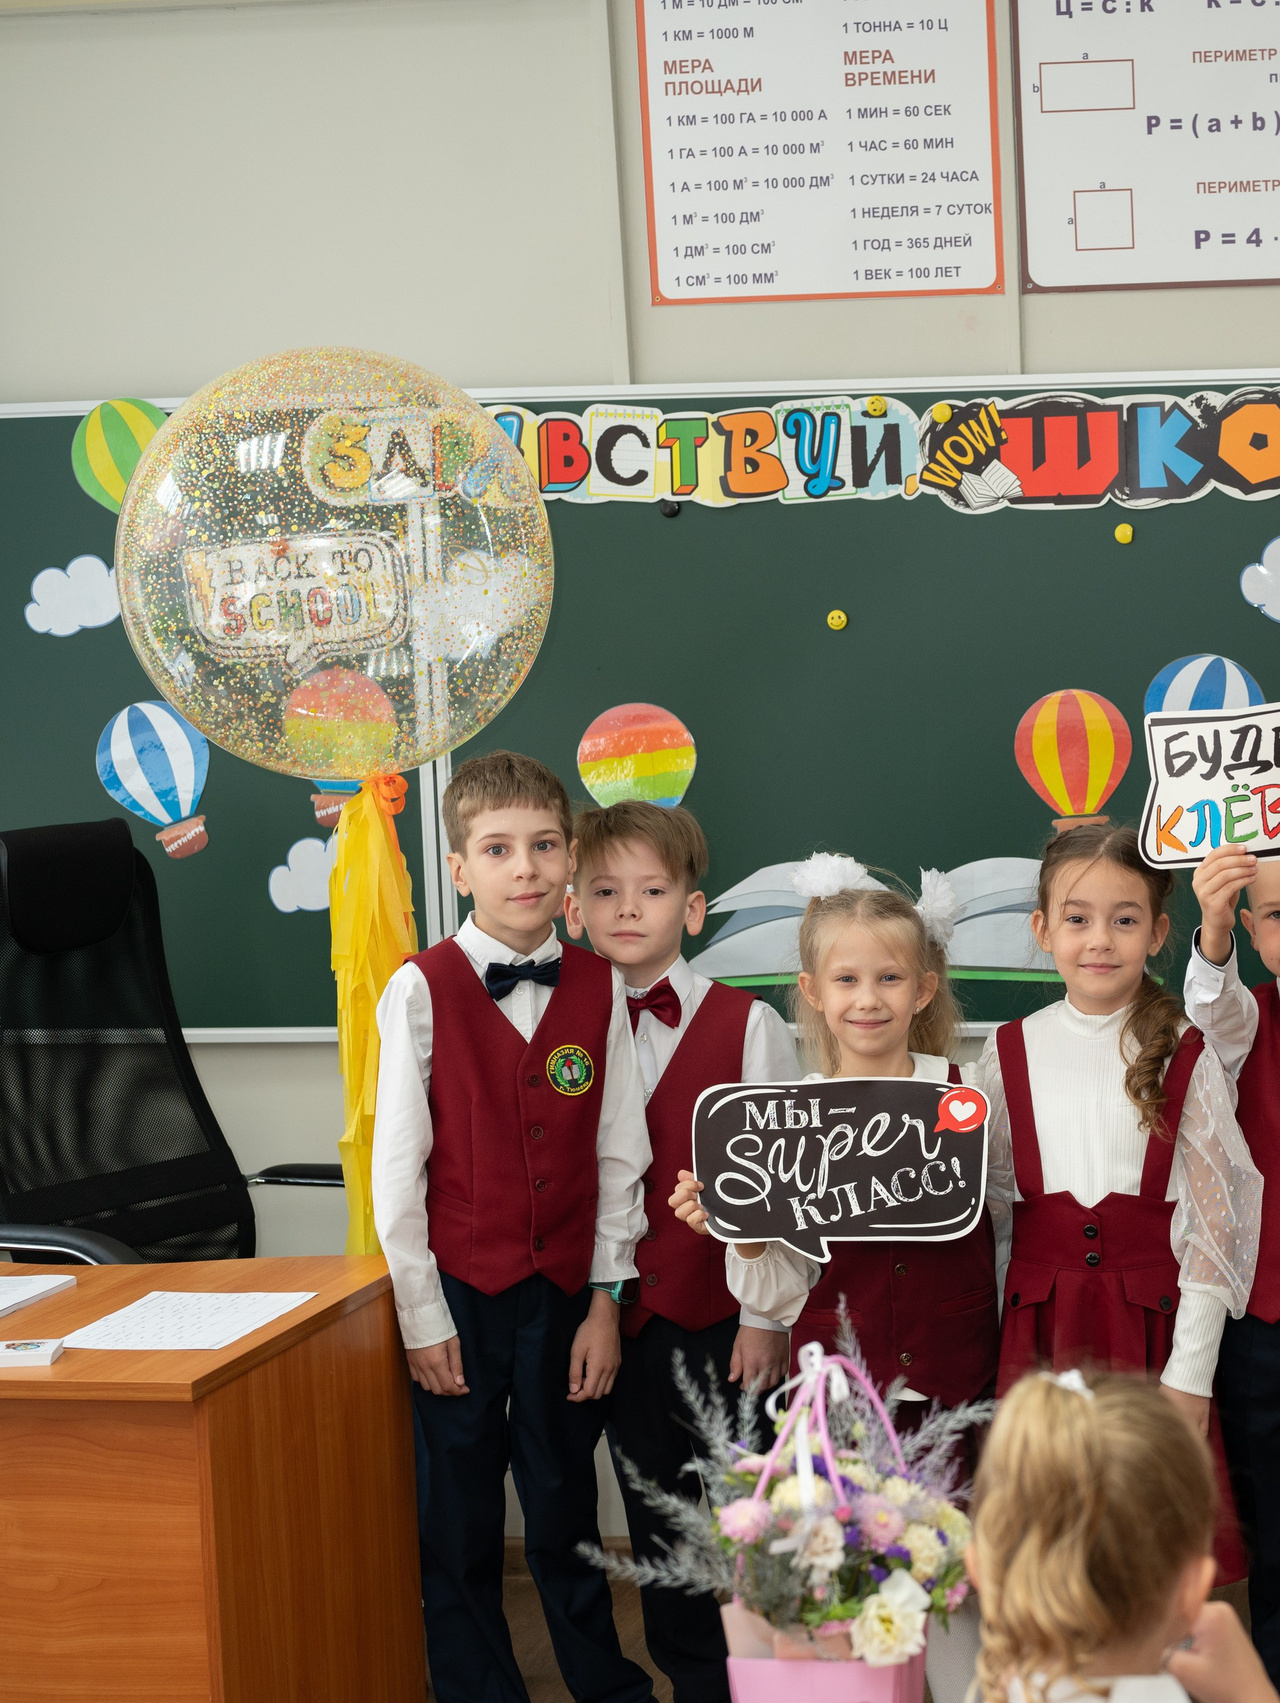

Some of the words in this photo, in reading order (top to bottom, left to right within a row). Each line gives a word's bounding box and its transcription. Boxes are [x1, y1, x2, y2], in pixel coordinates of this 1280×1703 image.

[662, 30, 668, 42] 1
[673, 29, 693, 42] КМ
[708, 27, 739, 40] 1000
[743, 26, 754, 39] М
[842, 22, 848, 34] 1
[853, 20, 903, 34] ТОННА
[918, 18, 934, 31] 10
[938, 18, 949, 32] Ц
[843, 49, 895, 66] МЕРА
[1191, 47, 1278, 64] ПЕРИМЕТР
[663, 58, 715, 75] МЕРА
[844, 68, 936, 87] ВРЕМЕНИ
[664, 77, 762, 97] ПЛОЩАДИ
[666, 115, 672, 127] 1
[677, 114, 697, 127] КМ
[712, 112, 736, 125] 100
[739, 112, 757, 124] ГА
[772, 110, 787, 123] 10
[790, 109, 814, 122] 000
[817, 109, 828, 121] А
[846, 108, 852, 120] 1
[857, 106, 889, 119] МИН
[904, 105, 920, 118] 60
[923, 104, 952, 117] СЕК
[667, 148, 674, 160] 1
[679, 147, 696, 160] ГА
[711, 145, 734, 158] 100
[737, 145, 748, 157] А
[763, 144, 779, 156] 10
[782, 143, 806, 155] 000
[847, 141, 854, 153] 1
[858, 139, 888, 152] ЧАС
[903, 138, 919, 151] 60
[923, 137, 954, 150] МИН
[669, 181, 676, 193] 1
[680, 181, 691, 193] А
[706, 179, 729, 192] 100
[763, 177, 779, 189] 10
[782, 176, 806, 189] 000
[849, 174, 855, 186] 1
[860, 172, 905, 186] СУТКИ
[921, 171, 937, 184] 24
[940, 170, 980, 183] ЧАСА
[671, 214, 677, 226] 1
[713, 212, 736, 224] 100
[850, 207, 857, 219] 1
[861, 205, 919, 220] НЕДЕЛЯ
[934, 204, 943, 216] 7
[946, 202, 993, 216] СУТОК
[673, 246, 679, 258] 1
[724, 243, 747, 256] 100
[851, 239, 858, 251] 1
[863, 238, 892, 252] ГОД
[906, 237, 930, 249] 365
[933, 233, 972, 251] ДНЕЙ
[674, 275, 681, 287] 1
[726, 273, 748, 285] 100
[853, 269, 859, 281] 1
[864, 268, 892, 281] ВЕК
[907, 267, 931, 279] 100
[934, 265, 962, 278] ЛЕТ
[922, 400, 1011, 488] WOW!
[226, 552, 315, 586] BACK
[332, 548, 373, 576] TO
[220, 582, 382, 637] SCHOOL
[714, 1112, 942, 1212] Super
[786, 1156, 967, 1231] КЛАСС!
